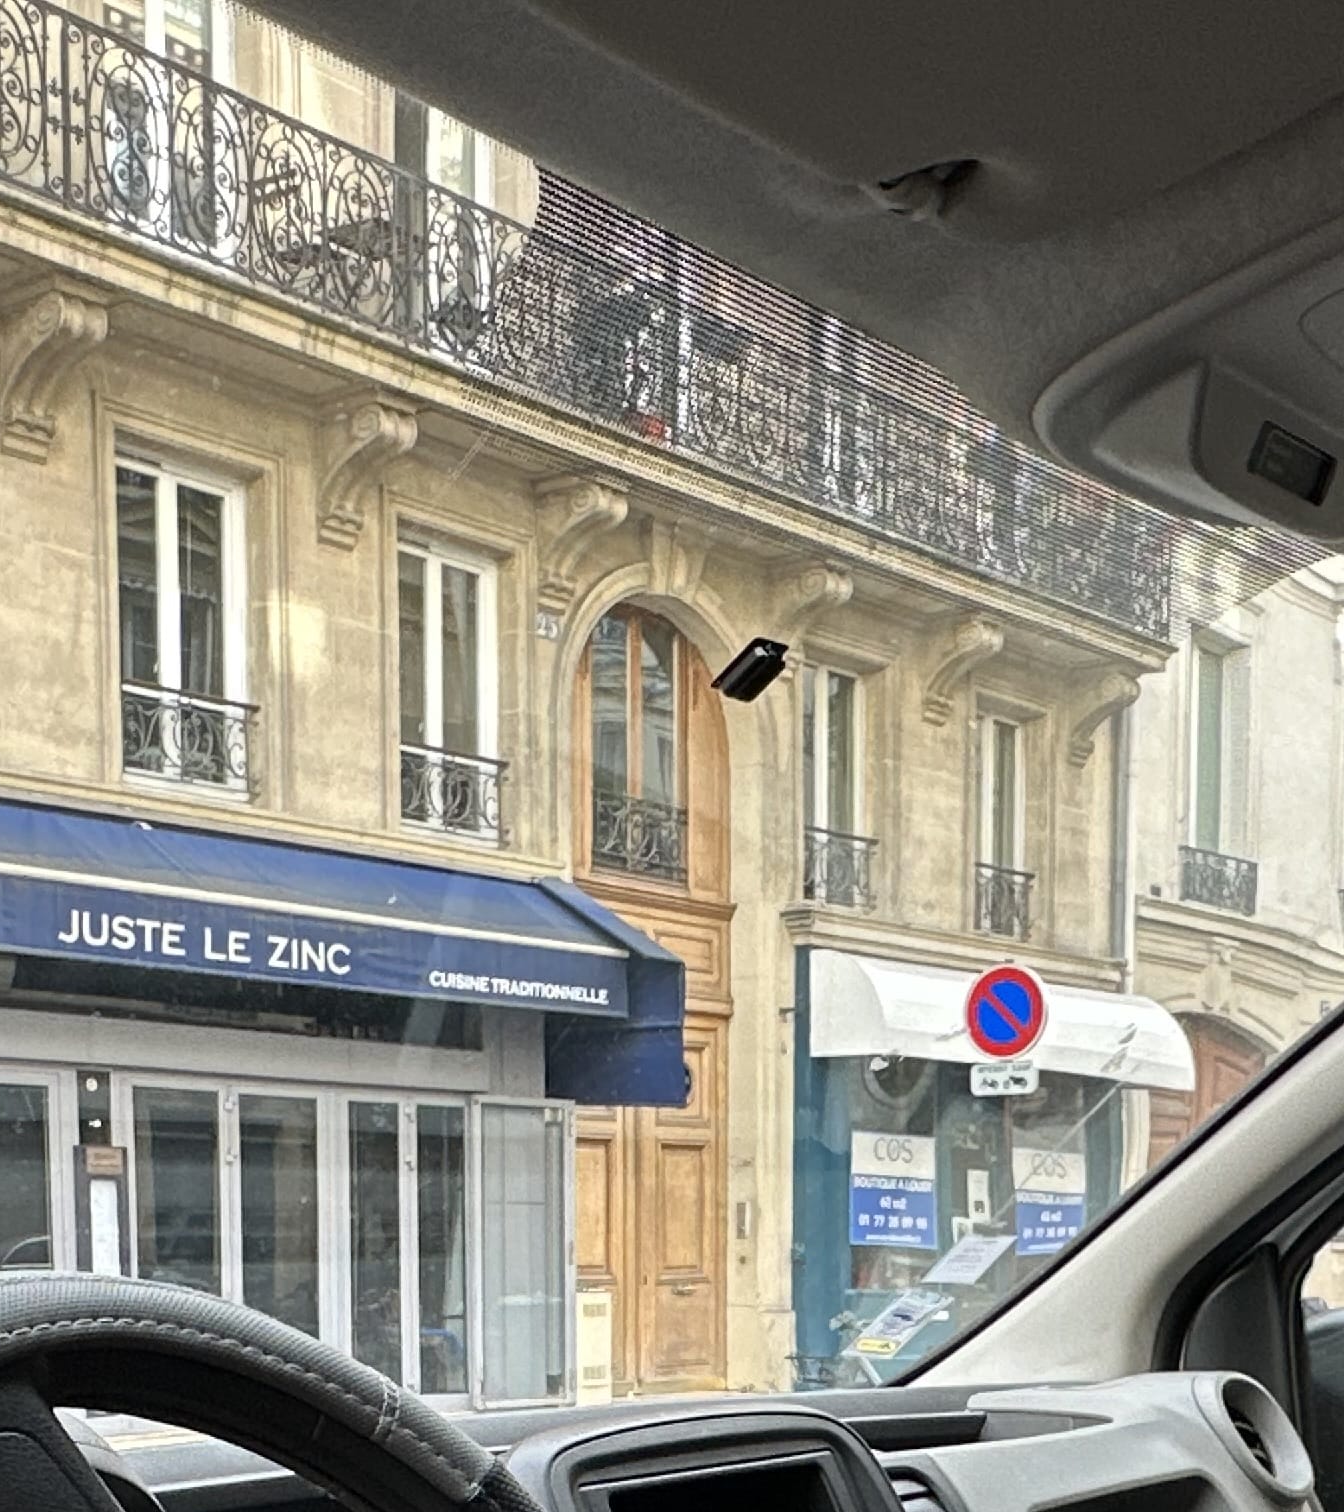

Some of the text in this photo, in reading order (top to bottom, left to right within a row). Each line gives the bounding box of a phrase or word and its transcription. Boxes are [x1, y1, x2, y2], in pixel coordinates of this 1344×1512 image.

[58, 908, 352, 976] JUSTE LE ZINC
[428, 969, 610, 1006] CUISINE TRADITIONNELLE
[873, 1137, 914, 1165] COS
